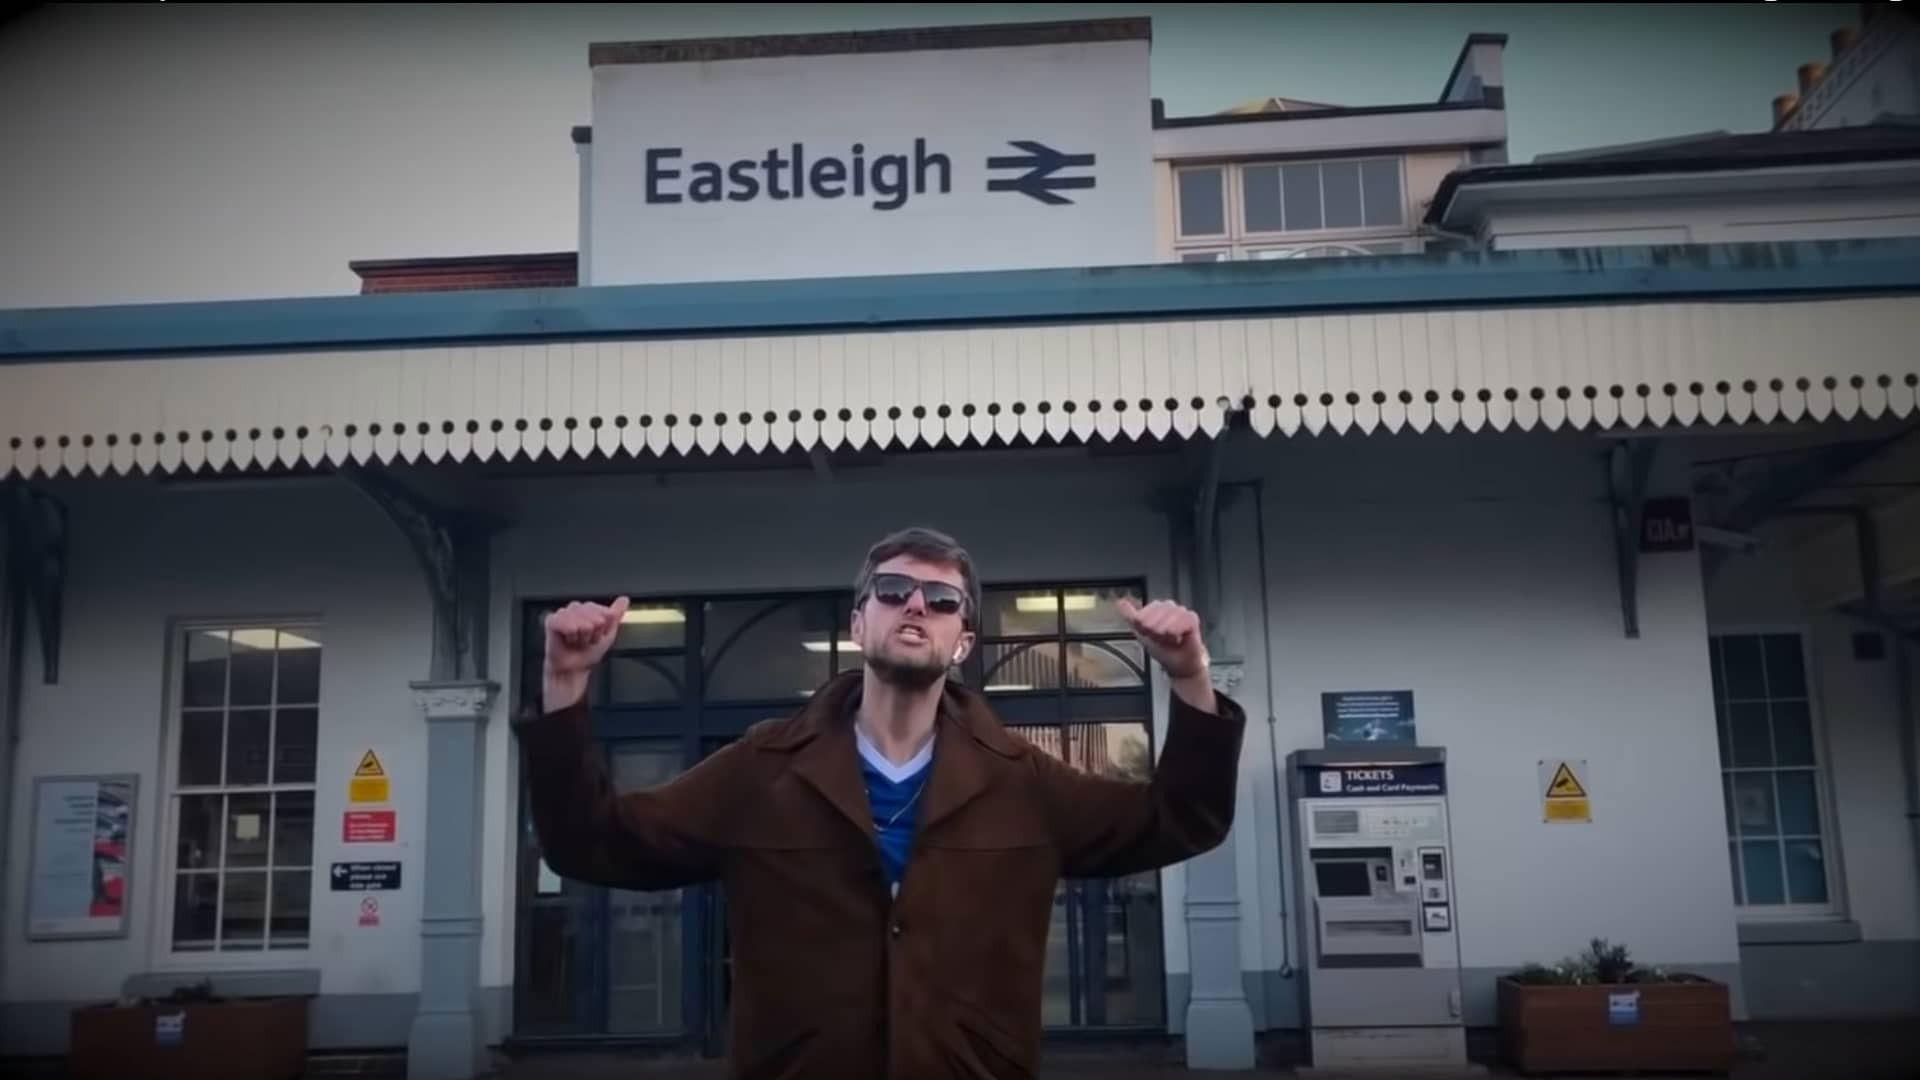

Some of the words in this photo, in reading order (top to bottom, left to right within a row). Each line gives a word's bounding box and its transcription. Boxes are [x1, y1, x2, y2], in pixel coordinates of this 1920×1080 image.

[645, 138, 951, 211] Eastleigh
[1346, 770, 1394, 780] TICKETS
[1346, 784, 1364, 793] Cash
[1366, 783, 1380, 792] and
[1382, 783, 1400, 792] Card
[1401, 783, 1440, 793] Payments
